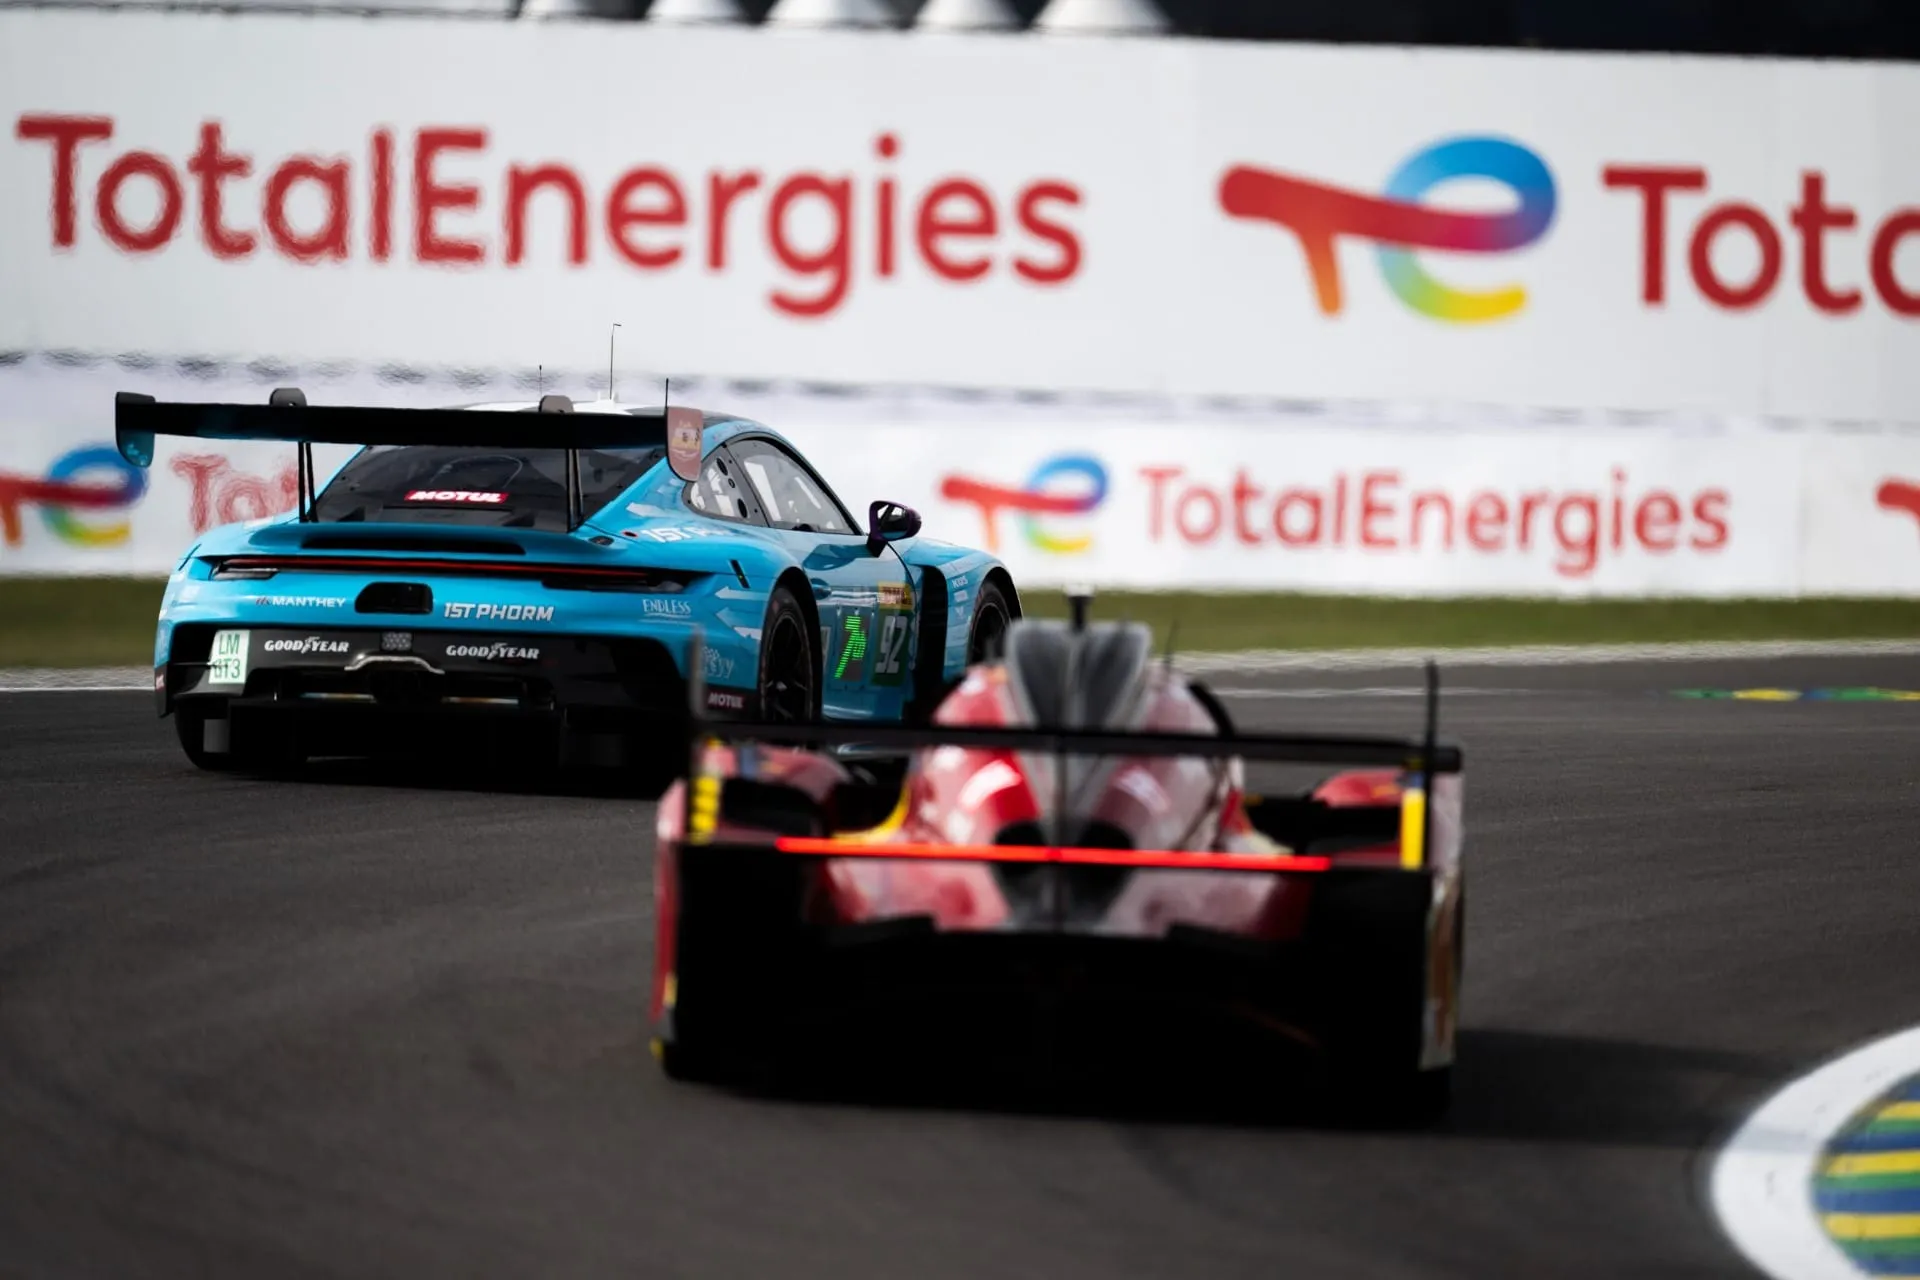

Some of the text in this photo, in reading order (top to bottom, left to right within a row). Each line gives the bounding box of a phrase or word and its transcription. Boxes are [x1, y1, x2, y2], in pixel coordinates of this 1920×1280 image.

[16, 114, 1084, 318] TotalEnergies
[409, 490, 501, 503] MOTUL
[1140, 466, 1730, 577] TotalEnergies
[272, 596, 346, 608] MANTHEY
[642, 599, 692, 614] ENDLESS
[219, 633, 240, 655] LM
[264, 636, 349, 653] GOODYEAR
[446, 642, 539, 660] GOODYEAR
[875, 615, 908, 674] 92
